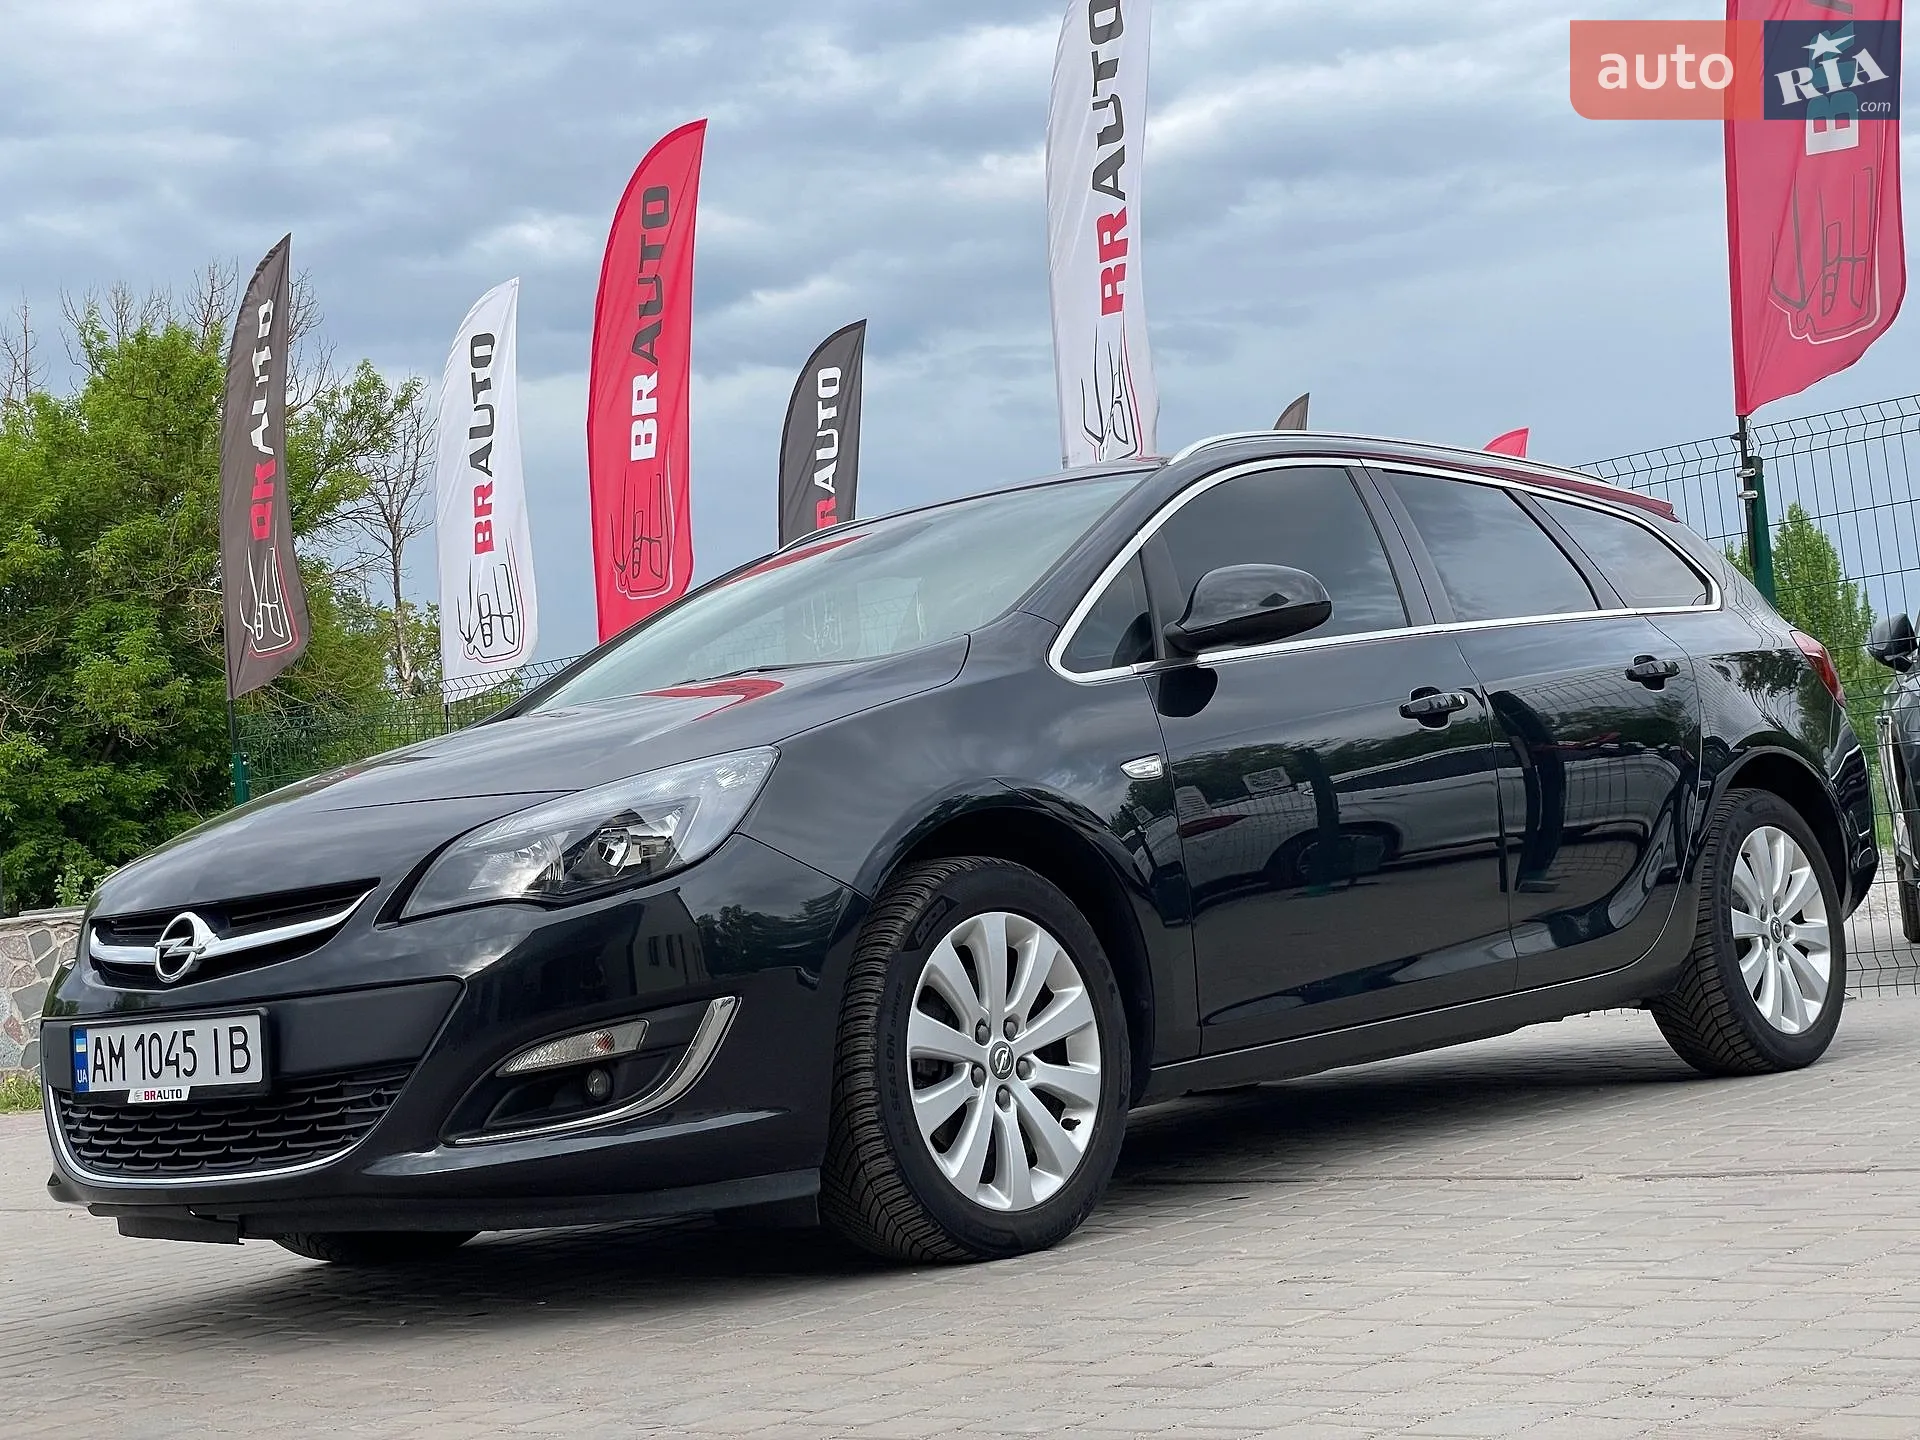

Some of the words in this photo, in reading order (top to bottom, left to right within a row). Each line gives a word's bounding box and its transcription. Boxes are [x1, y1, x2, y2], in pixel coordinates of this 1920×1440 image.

[630, 185, 670, 463] BRAUTO
[469, 332, 497, 555] BRAUTO
[813, 366, 842, 530] RAUTO
[76, 1069, 88, 1084] UA
[92, 1034, 126, 1083] AM
[134, 1029, 198, 1081] 1045
[144, 1088, 183, 1101] BRAUTO
[886, 1032, 902, 1112] SEASON
